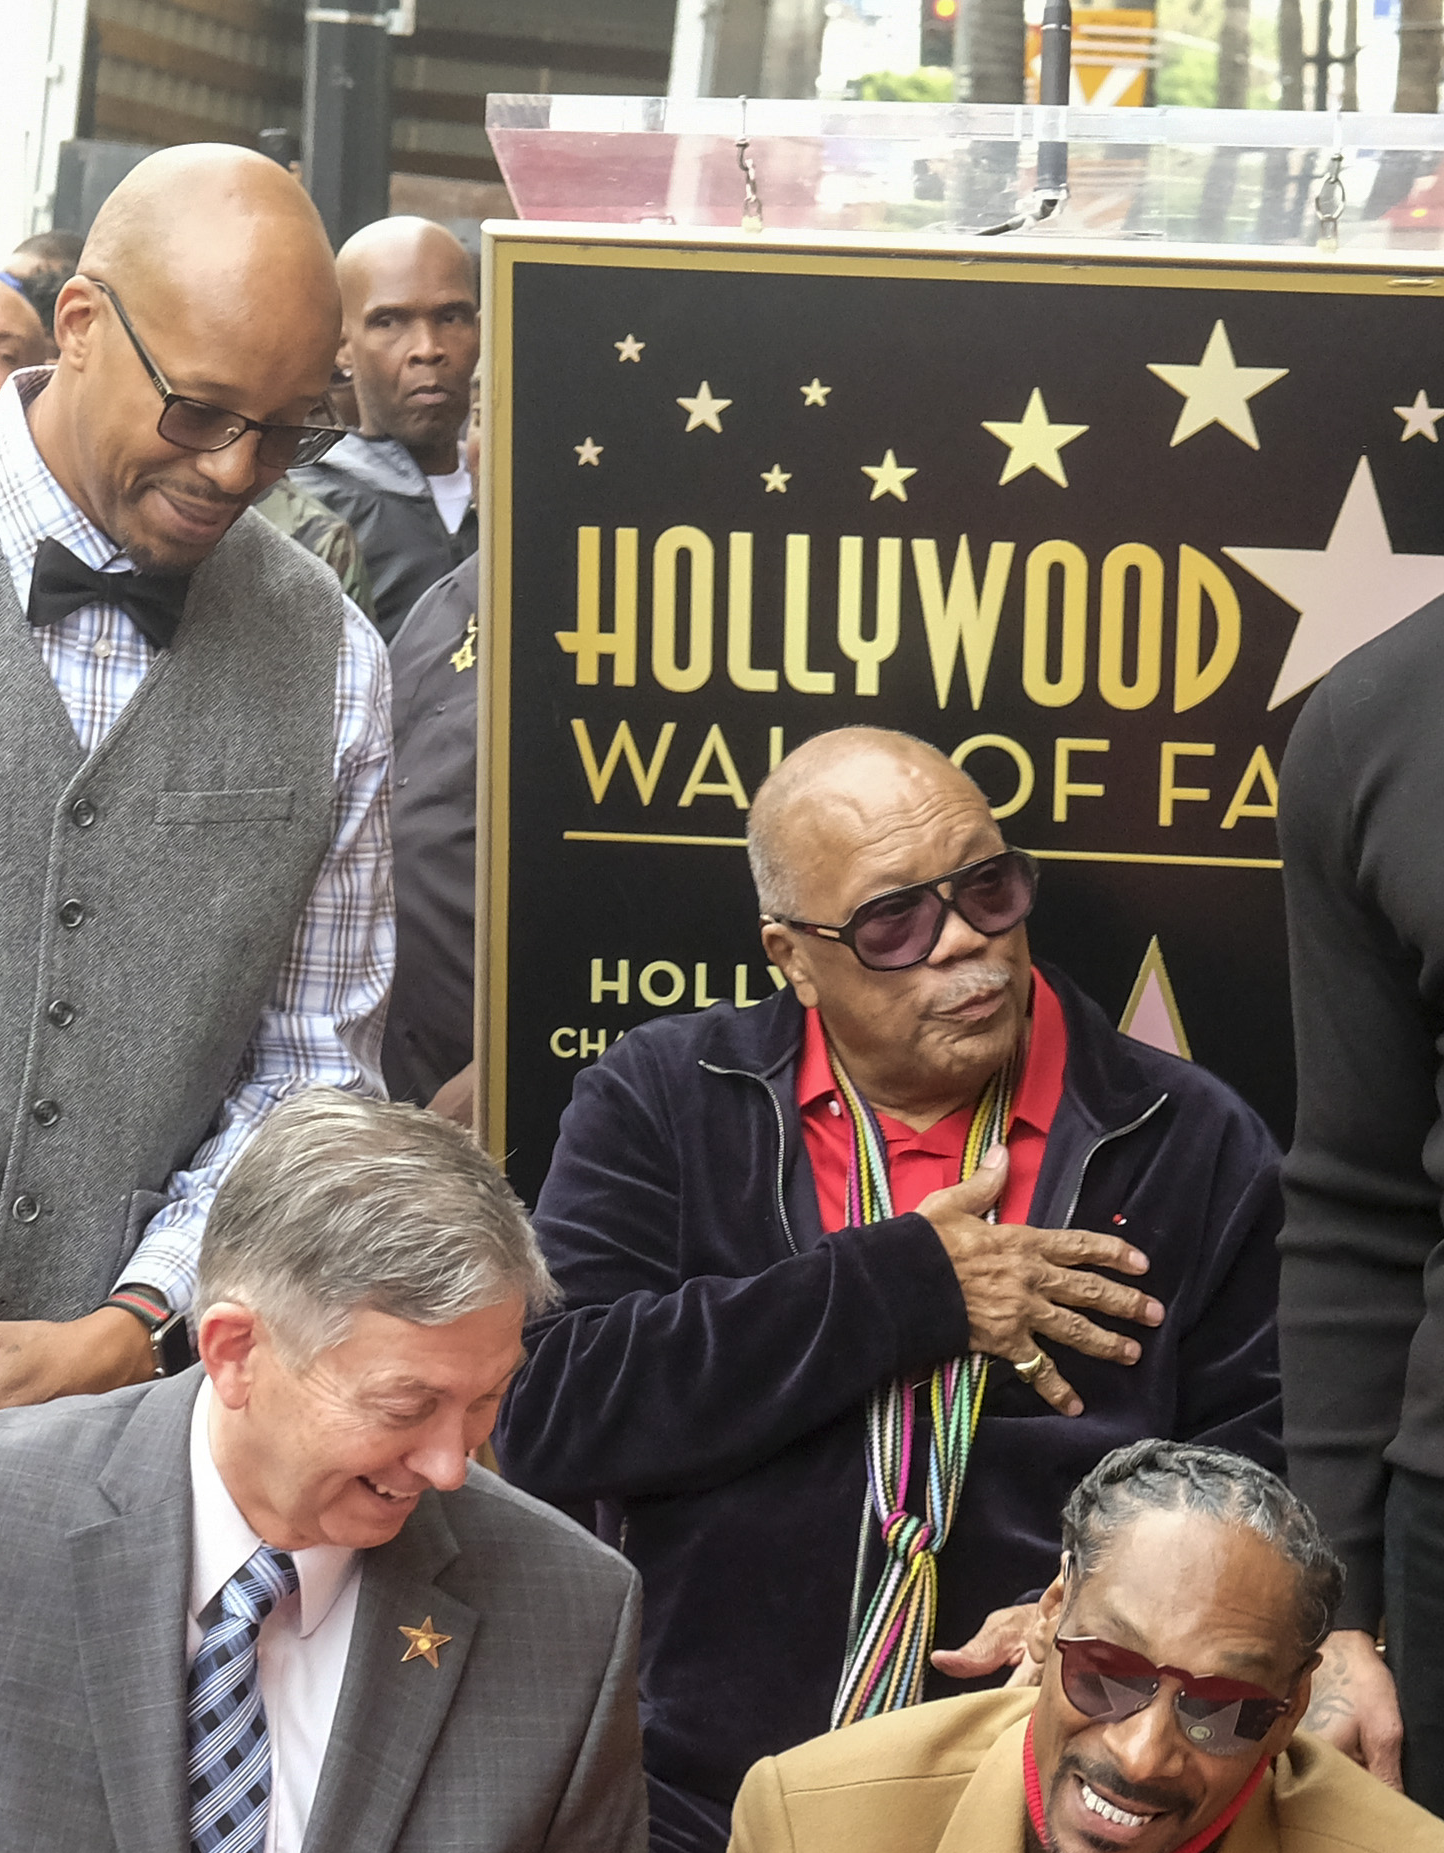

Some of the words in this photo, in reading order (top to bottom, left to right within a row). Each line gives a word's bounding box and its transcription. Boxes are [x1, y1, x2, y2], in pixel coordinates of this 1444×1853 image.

[556, 525, 1241, 713] HOLLYWOOD
[953, 733, 1111, 823] OF
[550, 1026, 625, 1060] CH
